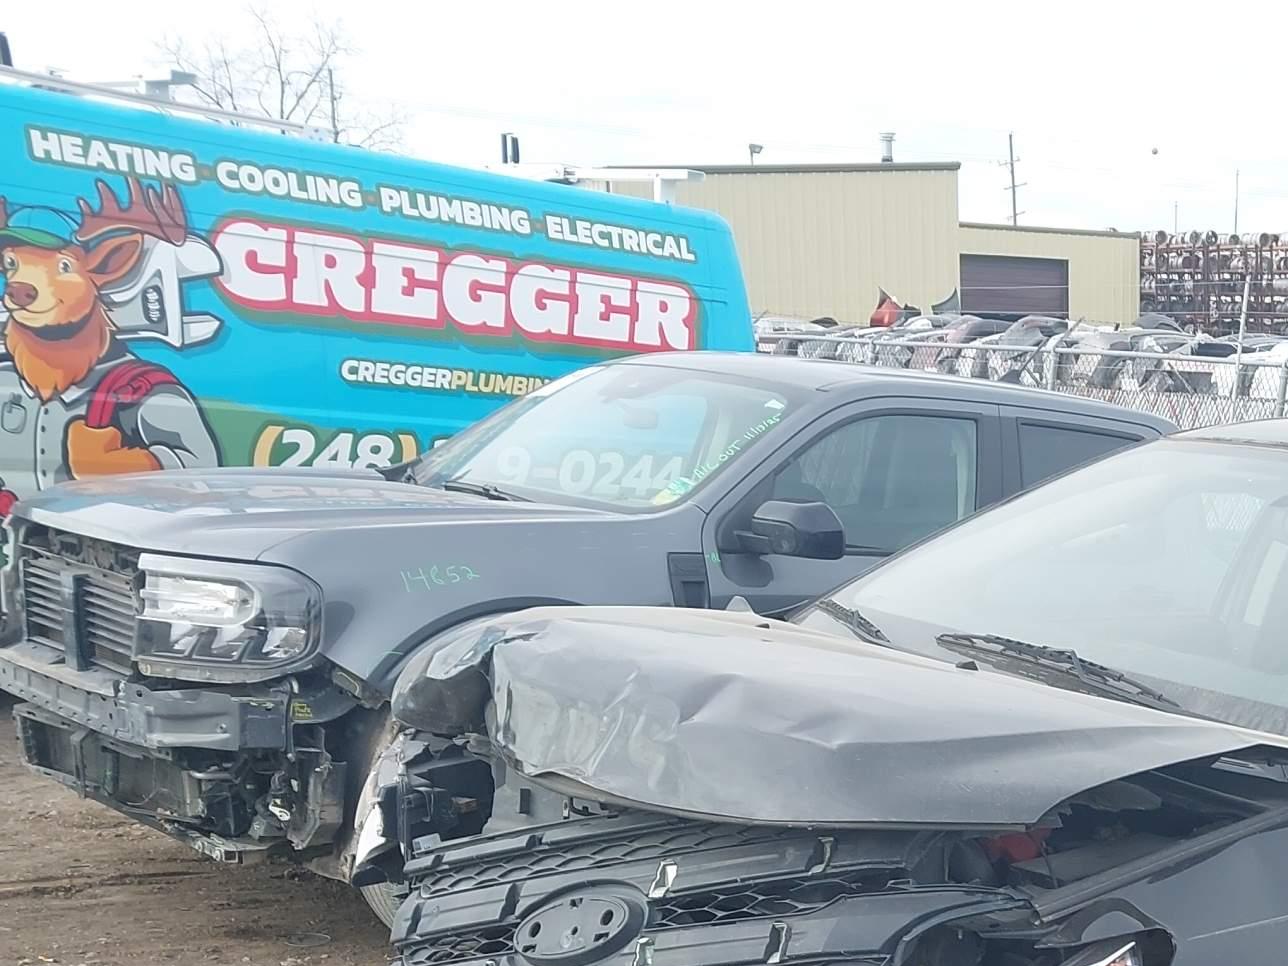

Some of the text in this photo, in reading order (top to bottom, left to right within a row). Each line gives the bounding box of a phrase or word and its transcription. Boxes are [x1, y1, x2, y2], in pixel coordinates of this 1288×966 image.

[28, 129, 696, 261] HEATING COOLING PLUMBING ELECTRICAL
[213, 221, 690, 351] CREGGER
